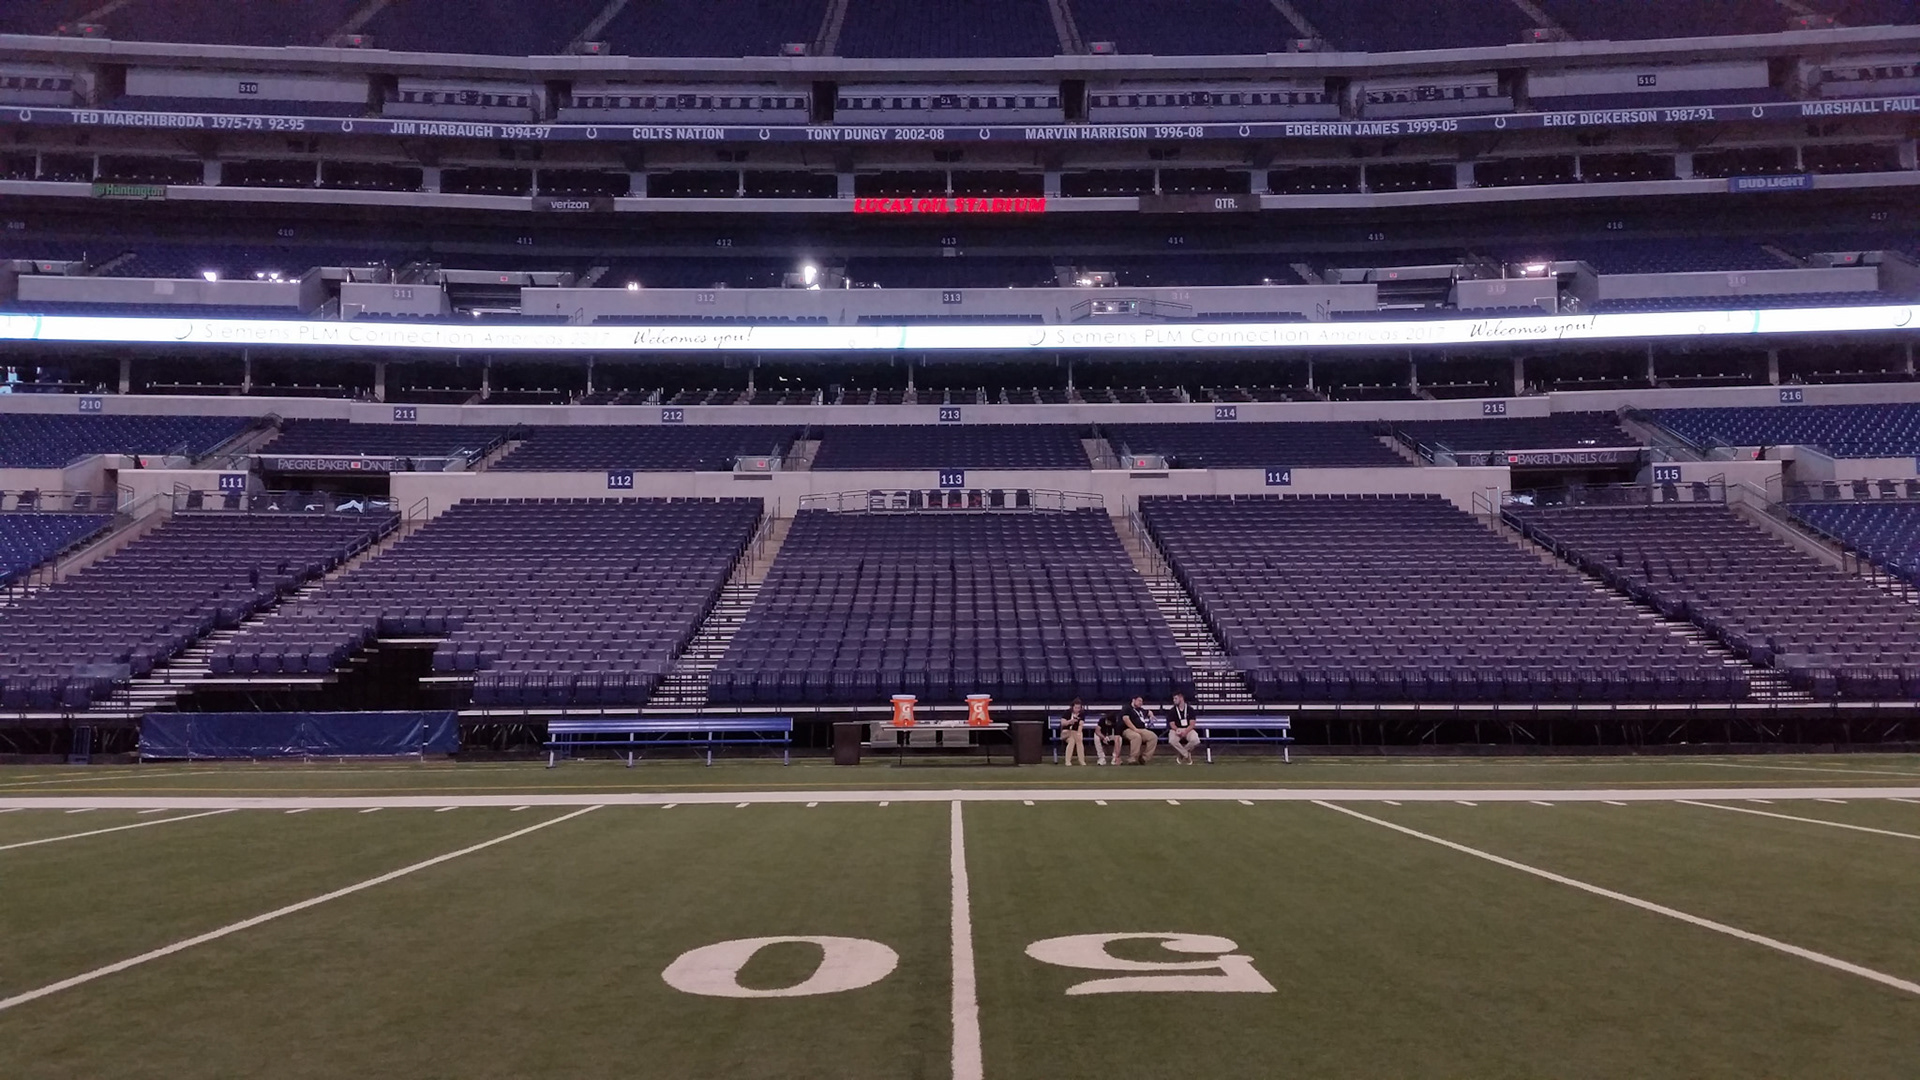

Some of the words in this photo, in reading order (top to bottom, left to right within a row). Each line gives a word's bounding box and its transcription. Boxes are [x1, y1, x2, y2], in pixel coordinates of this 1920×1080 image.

[1638, 76, 1656, 84] 516
[240, 84, 258, 92] 510
[1802, 100, 1879, 116] MARSHALL
[1884, 98, 1920, 112] FAUL
[71, 112, 98, 125] TED
[103, 113, 204, 128] MARCHIBRODA
[269, 118, 304, 130] 92-95
[1544, 114, 1576, 126] ERIC
[1580, 110, 1658, 125] DICKERSON
[1665, 108, 1714, 122] 1987-91
[390, 122, 416, 135] JIM
[420, 124, 493, 138] HARBAUGH
[500, 126, 550, 139] 1994-97
[1025, 128, 1077, 140] MARVIN
[1082, 128, 1148, 139] HARRISON
[1154, 126, 1204, 138] 1996-08
[1286, 124, 1352, 136] EDGERRIN
[1355, 122, 1400, 135] JAMES
[1407, 120, 1458, 133] 1999-05
[632, 128, 673, 140] COLTS
[676, 128, 724, 140] NATION
[806, 129, 840, 140] TONY
[844, 129, 888, 140] DUNGY
[895, 129, 945, 140] 2002-08
[1738, 178, 1766, 189] BUD
[1768, 176, 1805, 188] LIGHT
[106, 184, 164, 198] Huntington
[550, 199, 590, 210] verizon
[854, 198, 913, 213] LUCAS
[917, 198, 950, 213] OIL
[954, 198, 1046, 213] STADIUM
[1214, 198, 1238, 209] QTR.
[394, 290, 412, 298] 311
[944, 294, 961, 302] 313
[1172, 292, 1190, 300] 314
[1056, 328, 1136, 344] Semens
[1144, 328, 1182, 344] PLM
[1191, 328, 1310, 342] Connection
[1470, 320, 1548, 338] Welcomes
[1554, 316, 1596, 338] you!
[299, 325, 338, 340] PLM
[633, 328, 708, 345] Welcomes
[713, 327, 754, 348] you!
[1782, 392, 1802, 400] 216
[80, 400, 100, 410] 210
[1484, 404, 1504, 413] 215
[396, 410, 416, 420] 211
[663, 411, 682, 420] 212
[941, 410, 960, 420] 213
[1216, 408, 1236, 418] 214
[278, 459, 314, 470] FAEGRE
[318, 460, 350, 470] BAKER
[1470, 456, 1507, 466] FAERE
[1518, 454, 1550, 464] BAKER
[1552, 453, 1597, 464] DANIELS
[610, 475, 631, 486] 112
[941, 474, 962, 484] 113
[1268, 472, 1289, 482] 114
[1656, 470, 1678, 480] 115
[222, 478, 242, 488] 111
[974, 702, 983, 712] G
